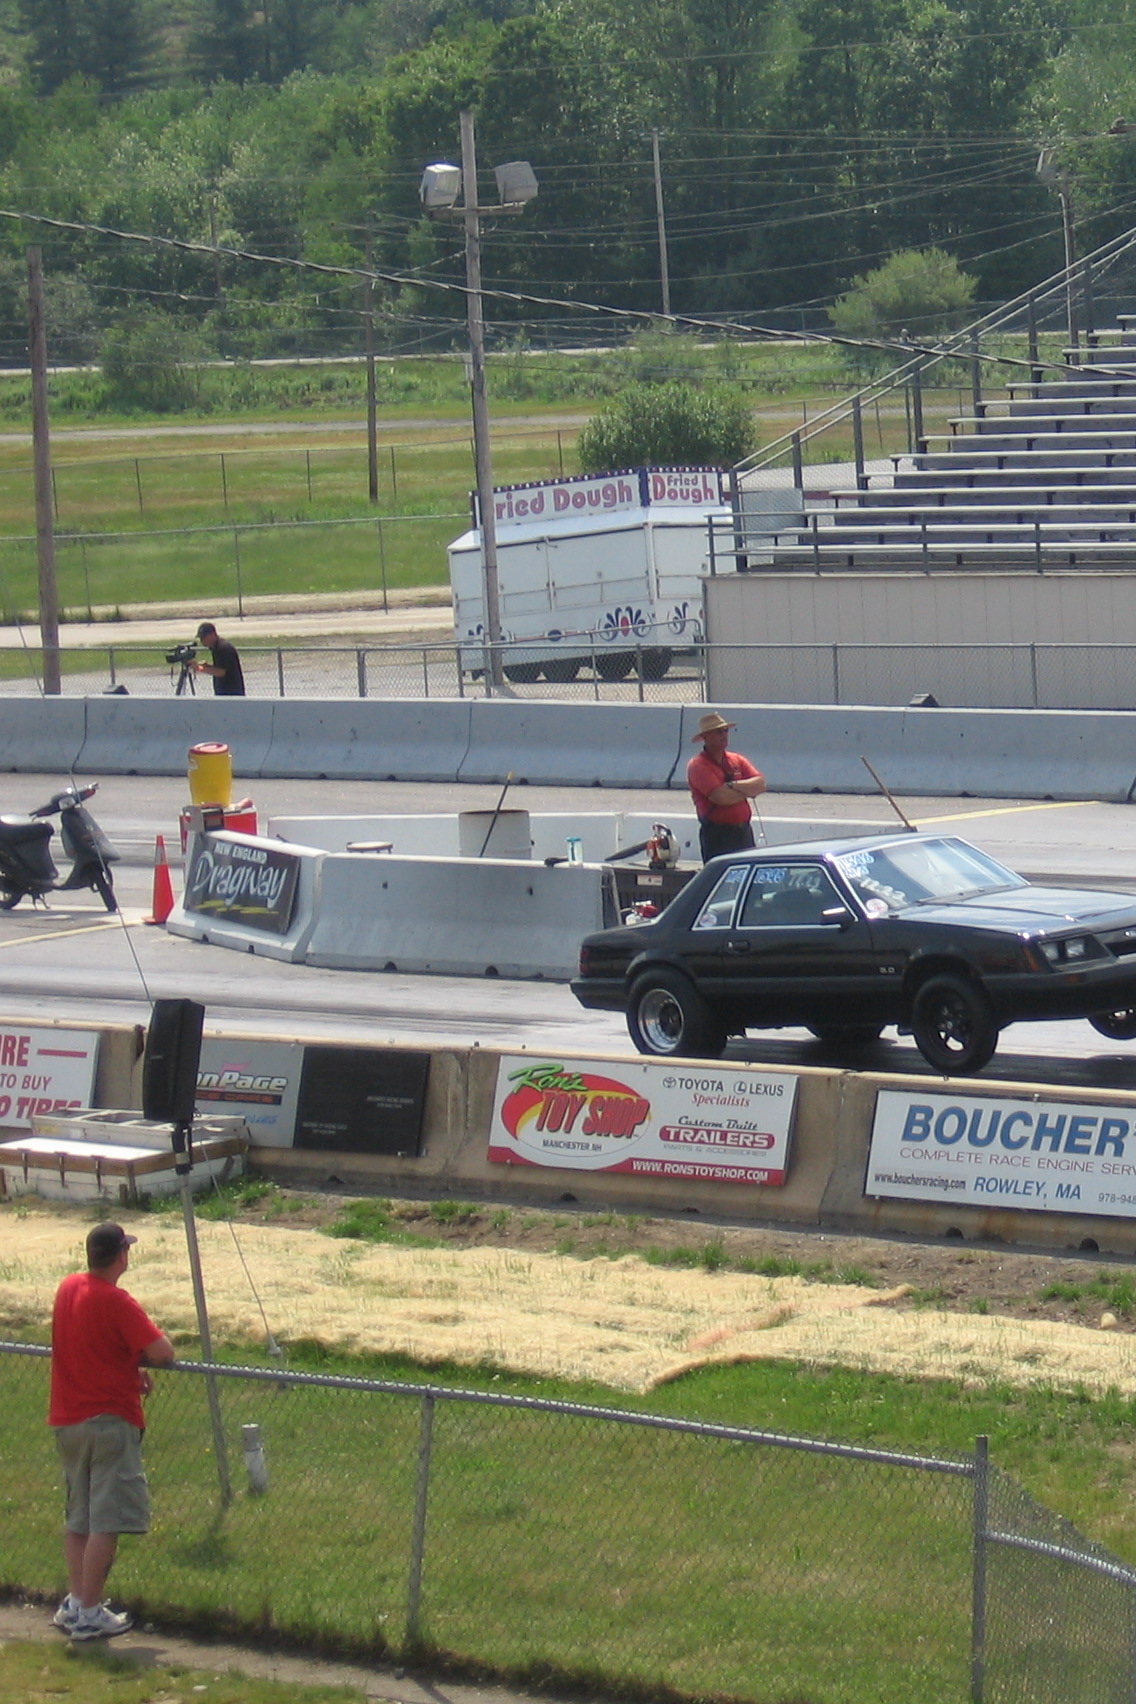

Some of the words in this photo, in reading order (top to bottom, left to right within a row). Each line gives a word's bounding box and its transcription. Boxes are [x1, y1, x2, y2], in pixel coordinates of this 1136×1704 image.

[492, 491, 545, 519] ried
[553, 480, 633, 511] Dough
[652, 474, 714, 503] Dough
[213, 842, 232, 855] NEW
[233, 845, 268, 864] ENGLAND
[192, 850, 288, 909] Dragway
[0, 1035, 31, 1067] RE
[0, 1073, 17, 1089] TO
[21, 1075, 52, 1091] BUY
[507, 1063, 589, 1093] Ron's
[678, 1077, 724, 1092] TOYOTA
[749, 1083, 785, 1097] LEXUS
[691, 1092, 752, 1107] Specialists
[535, 1091, 587, 1133] TOY
[581, 1095, 651, 1138] SHOP
[678, 1116, 723, 1129] Custom
[726, 1119, 758, 1131] Built
[542, 1138, 590, 1150] MANCHESTER
[665, 1126, 769, 1148] TRAILERS
[632, 1160, 769, 1181] WWW.RONSTOYSHOP.COM
[899, 1147, 984, 1164] COMPLETE
[989, 1154, 1032, 1168] RACE
[1037, 1157, 1095, 1173] ENGINE
[874, 1171, 966, 1191] www.bouchersracing.com
[973, 1176, 1048, 1199] ROWLEY,
[1055, 1183, 1082, 1200] MA
